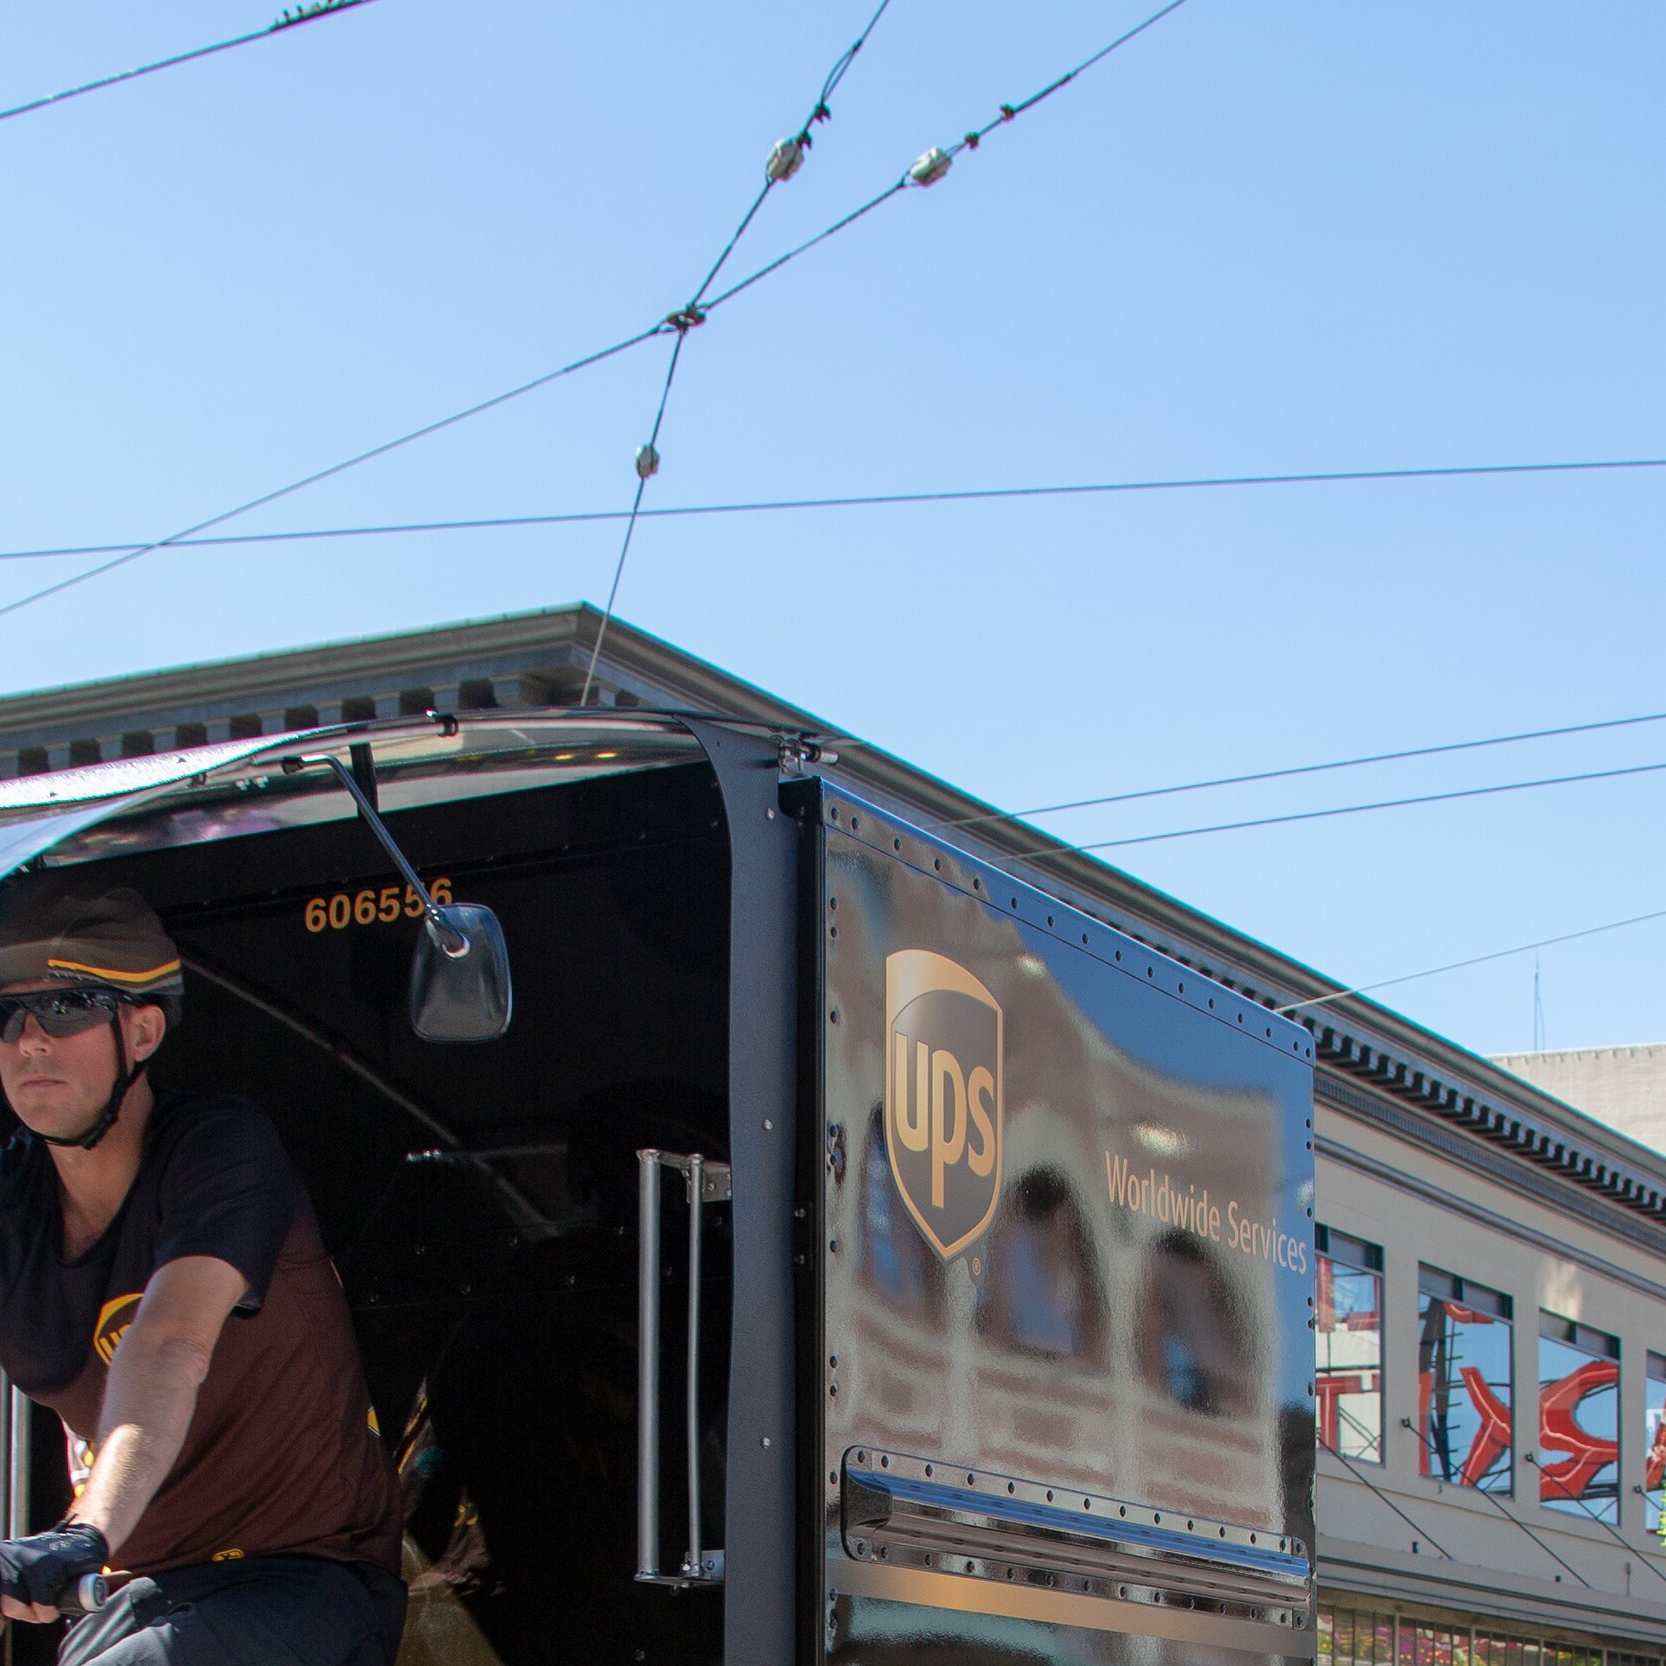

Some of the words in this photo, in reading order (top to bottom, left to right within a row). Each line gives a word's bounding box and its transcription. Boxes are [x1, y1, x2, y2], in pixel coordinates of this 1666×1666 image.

[304, 877, 453, 933] 606556
[894, 1031, 996, 1210] ups
[1104, 1151, 1221, 1242] Worldwide
[1226, 1201, 1308, 1276] Services
